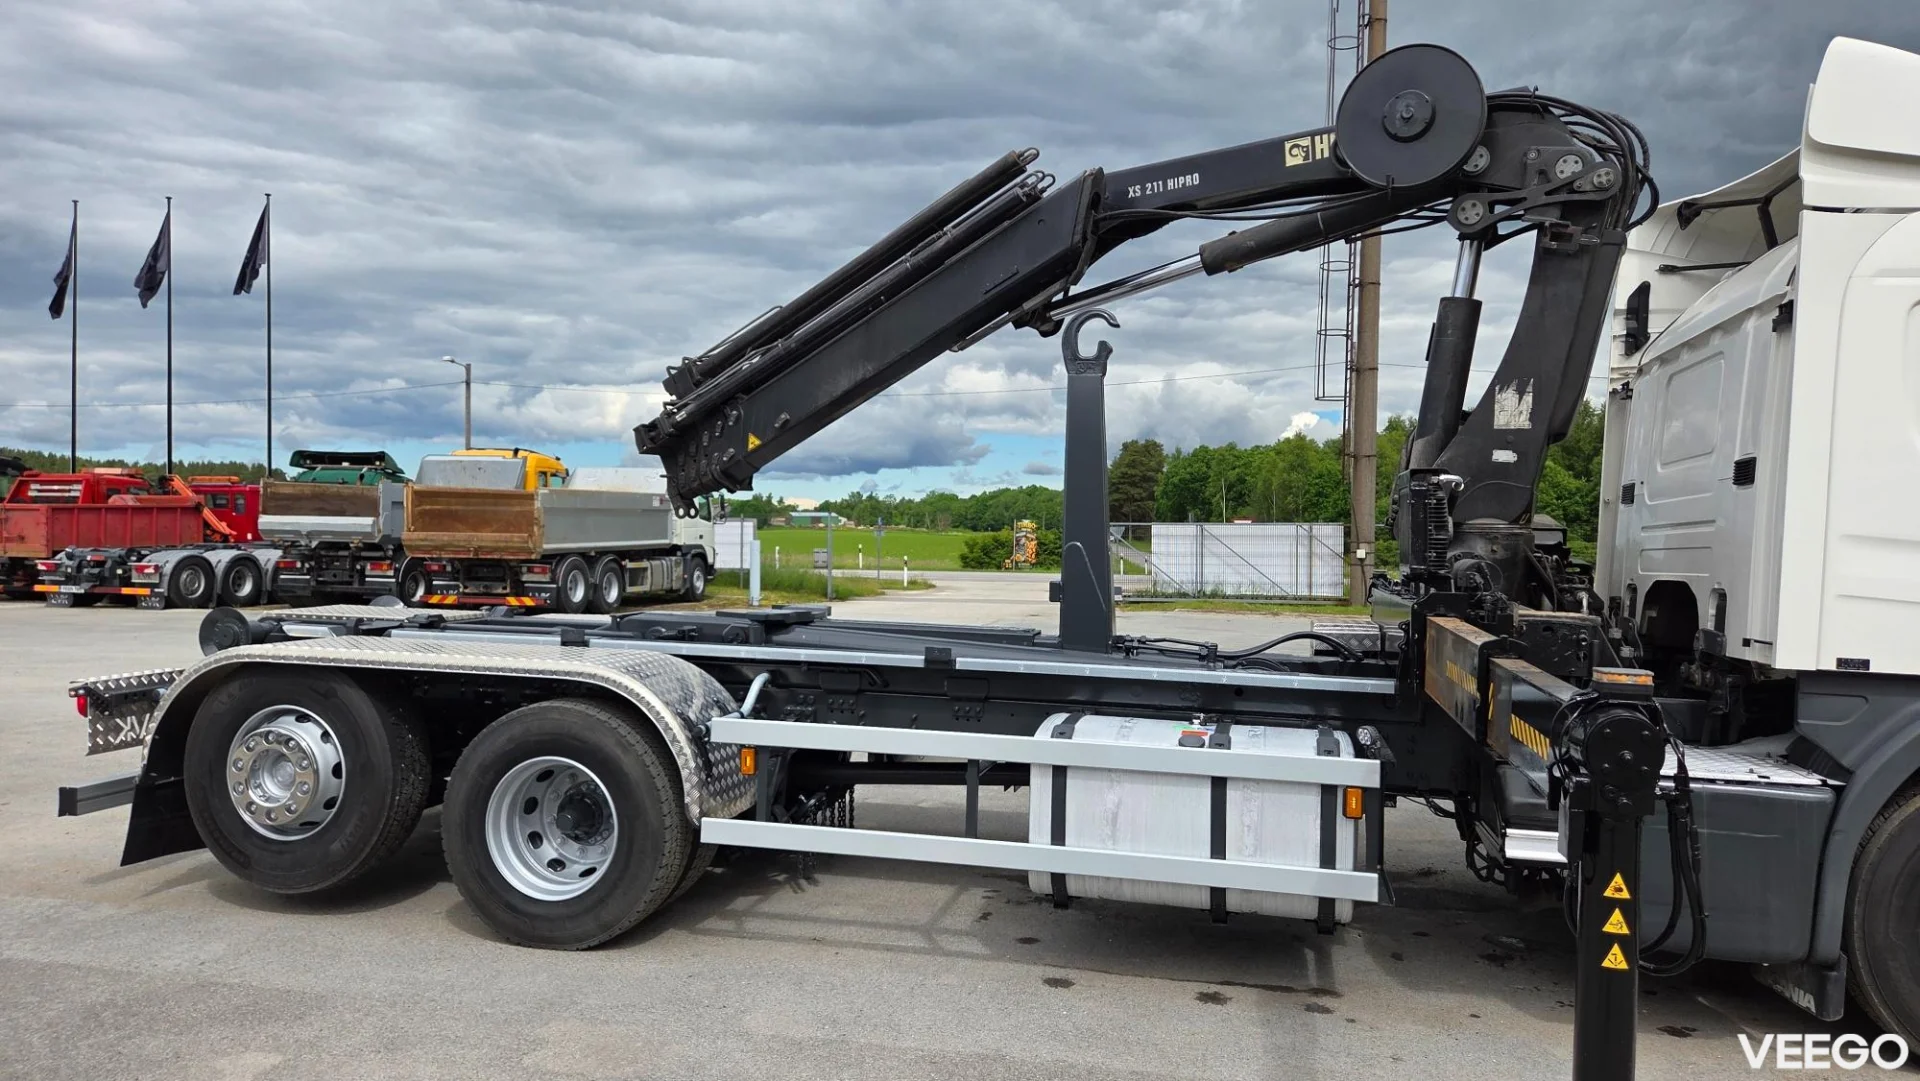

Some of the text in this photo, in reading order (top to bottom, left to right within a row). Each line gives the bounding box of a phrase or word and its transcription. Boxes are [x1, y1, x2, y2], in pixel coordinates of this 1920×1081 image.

[1127, 172, 1200, 199] XS 211 HIPRO
